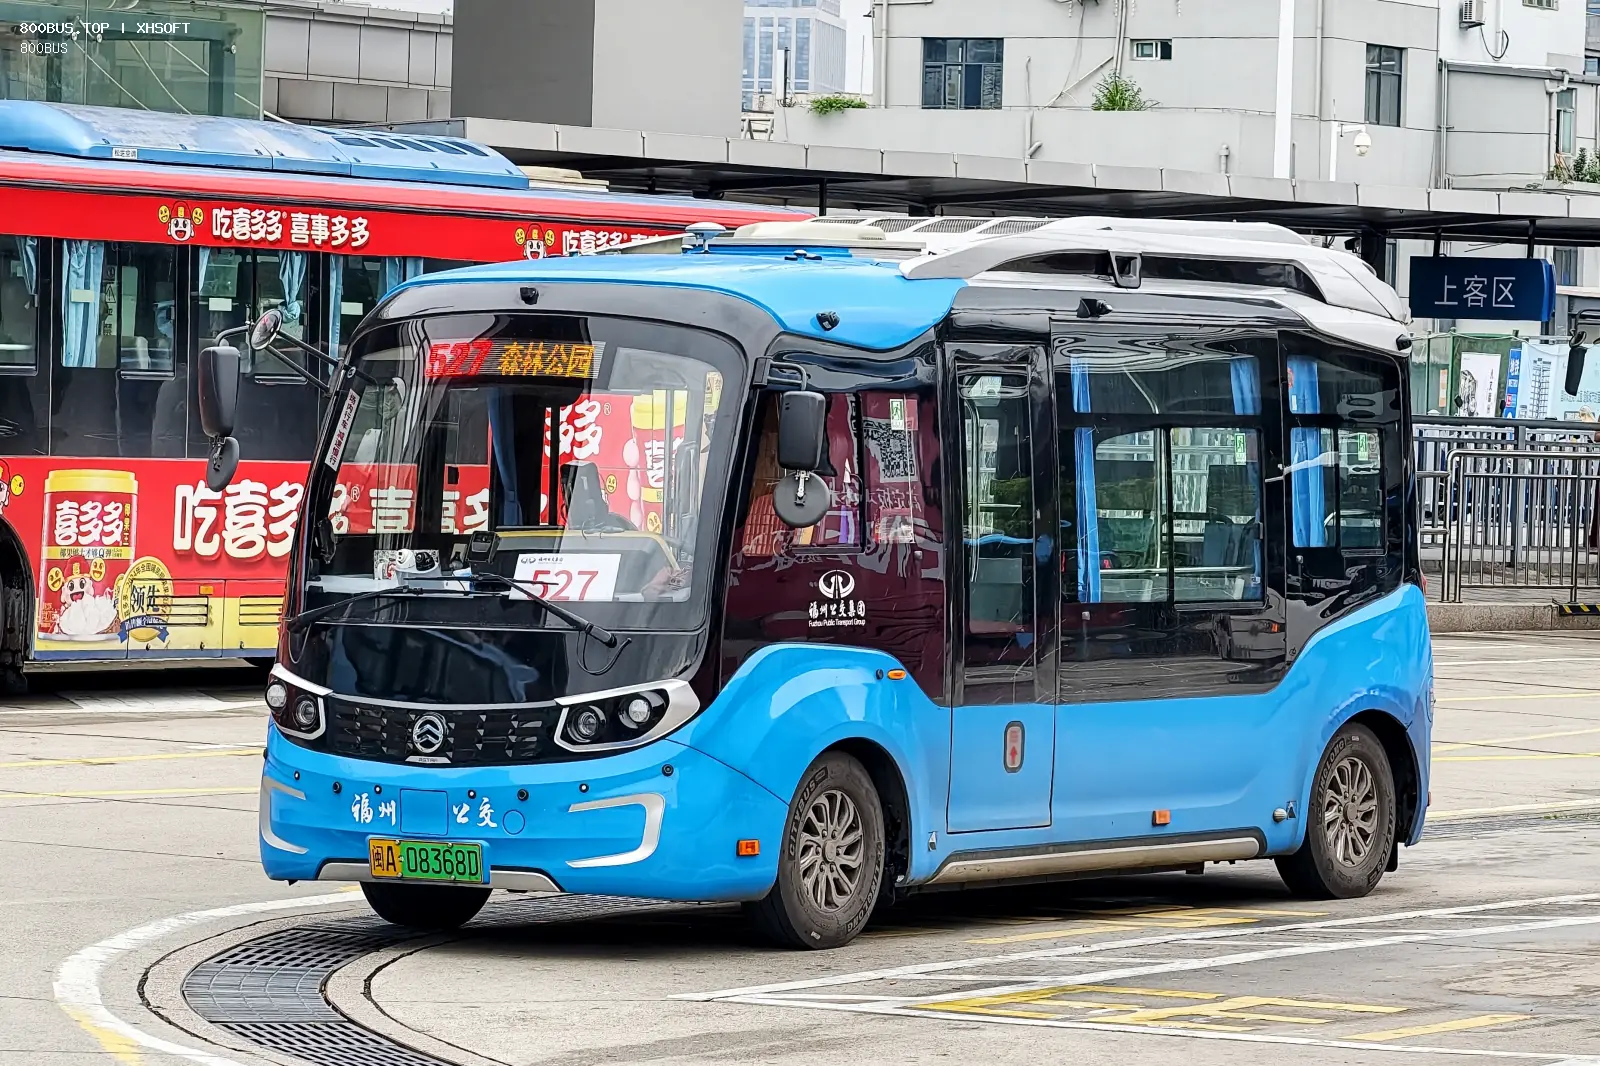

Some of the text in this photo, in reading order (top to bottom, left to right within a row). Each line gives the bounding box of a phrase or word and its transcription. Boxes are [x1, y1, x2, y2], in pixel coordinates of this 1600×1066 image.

[212, 207, 370, 247] 吃喜多多 喜事多多
[1434, 274, 1516, 308] 上客区
[425, 338, 595, 378] 527 森林公园
[54, 500, 124, 546] 喜多多
[527, 569, 599, 601] 527
[808, 600, 866, 619] 福州公交集团
[352, 793, 498, 828] 福州 公交
[788, 779, 817, 857] CITYBUS
